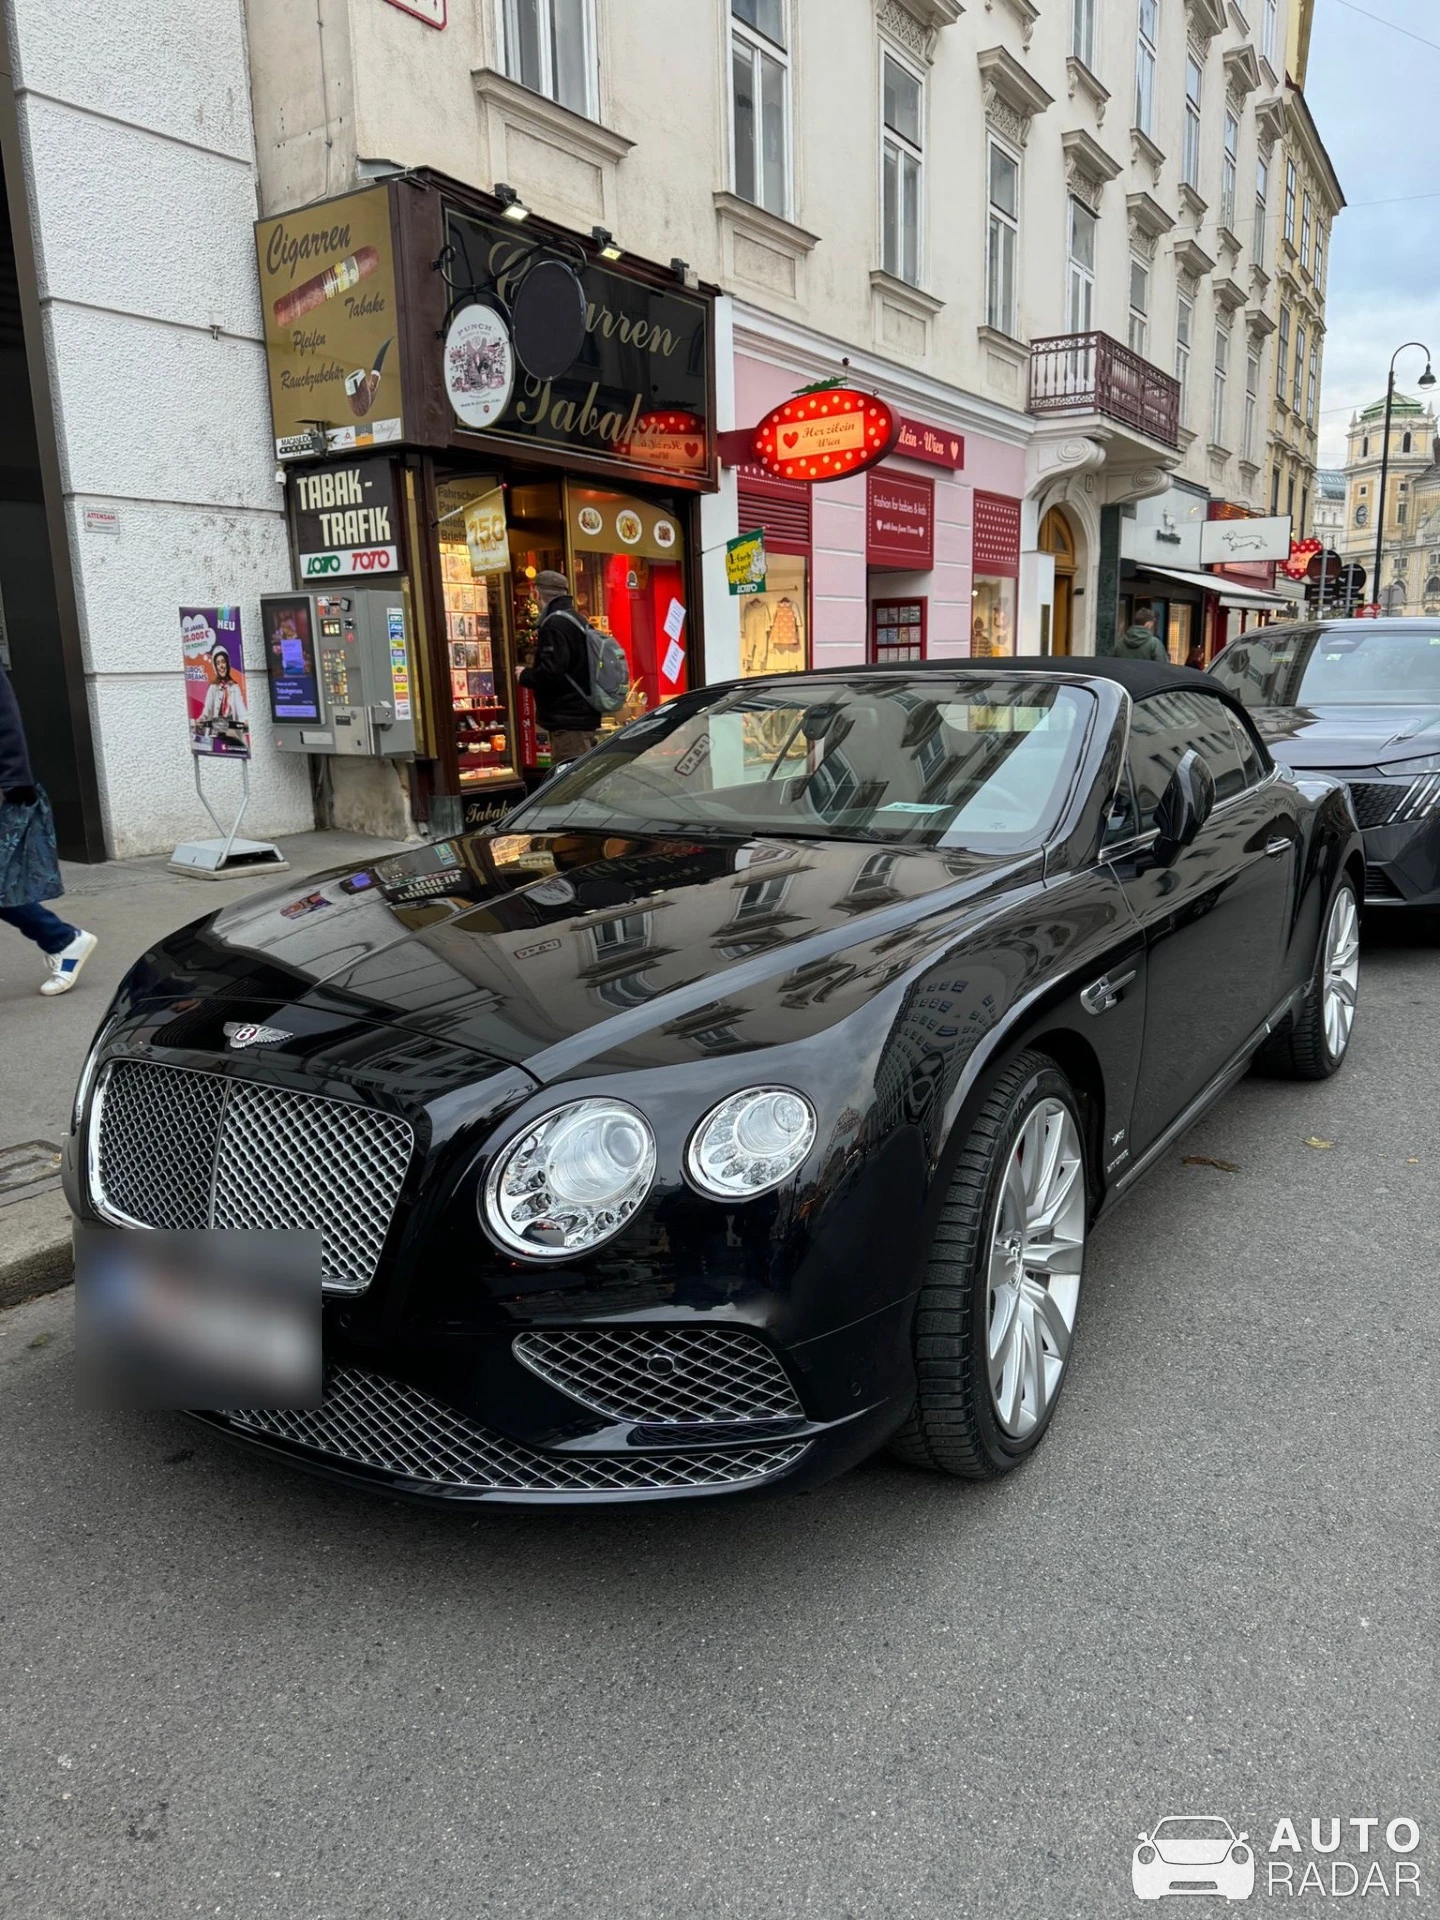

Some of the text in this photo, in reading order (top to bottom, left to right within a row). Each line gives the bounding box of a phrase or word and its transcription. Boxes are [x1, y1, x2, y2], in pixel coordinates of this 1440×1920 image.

[267, 223, 351, 279] Cigarren
[345, 292, 385, 319] Tabake
[457, 322, 492, 336] PUNCH
[293, 329, 326, 356] Pfeifen
[281, 362, 344, 392] Rauchzubehör
[802, 422, 855, 439] Herzilein
[817, 438, 841, 448] Wien
[923, 431, 944, 455] Wien
[319, 506, 391, 547] TRAFIK
[307, 550, 390, 575] LOTTO TOTO
[737, 584, 758, 594] LOTTO
[465, 800, 514, 823] Tabak
